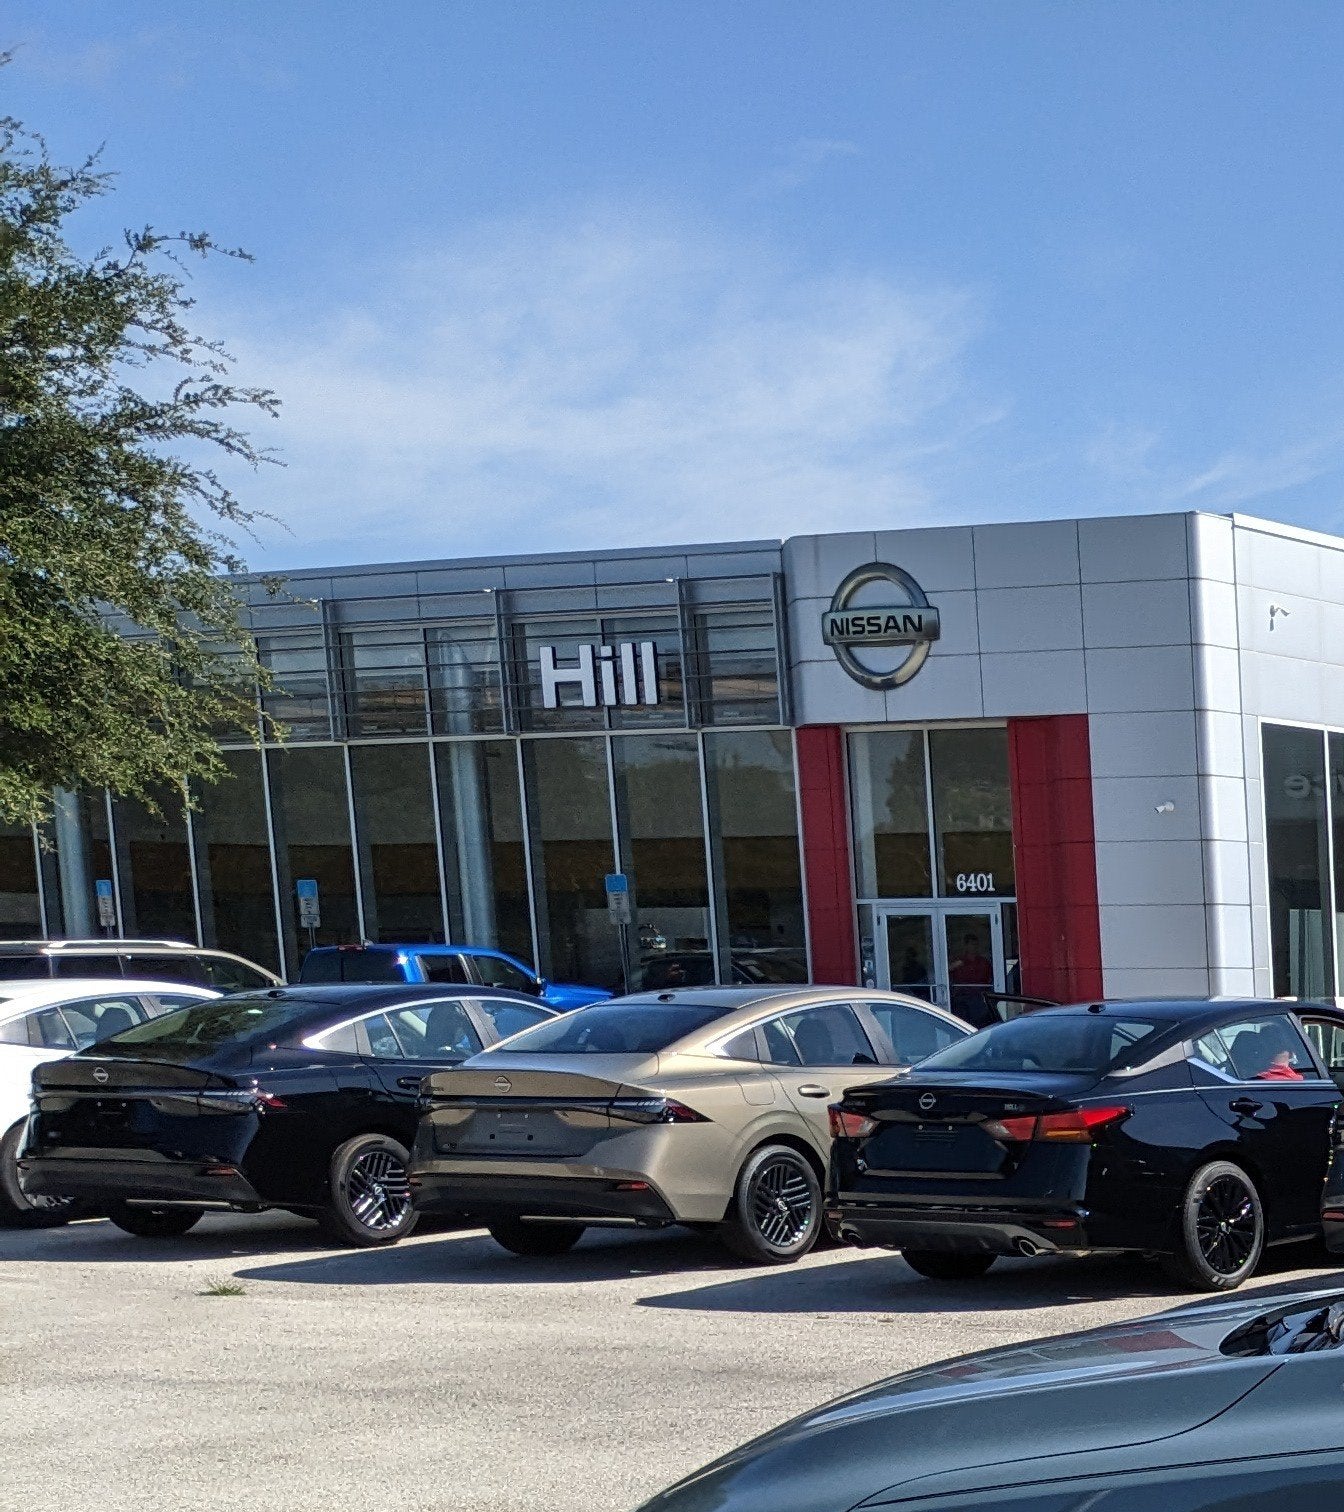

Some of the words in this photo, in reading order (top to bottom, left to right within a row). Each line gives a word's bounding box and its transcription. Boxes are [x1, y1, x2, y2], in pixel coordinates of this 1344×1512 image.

[829, 614, 922, 637] NISSAN
[539, 641, 660, 709] Hill
[956, 872, 996, 892] 6401
